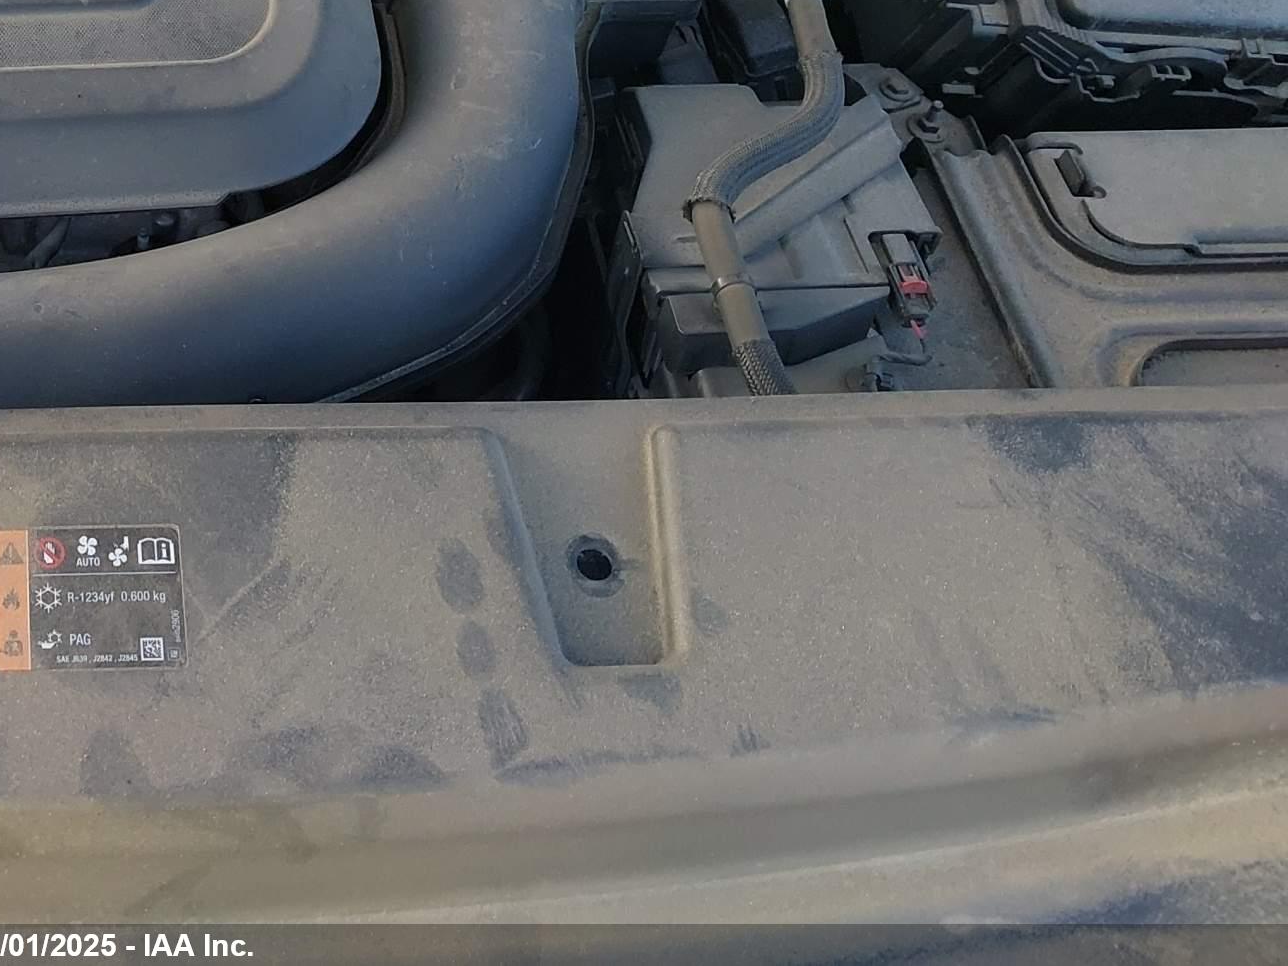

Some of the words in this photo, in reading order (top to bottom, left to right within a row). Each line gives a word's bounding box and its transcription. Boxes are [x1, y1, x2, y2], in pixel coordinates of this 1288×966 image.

[76, 557, 100, 568] AUTO
[67, 591, 114, 604] R-1234yf
[121, 590, 150, 602] 0.600
[153, 590, 166, 603] kg
[69, 633, 91, 646] PAG
[56, 655, 70, 663] SAE
